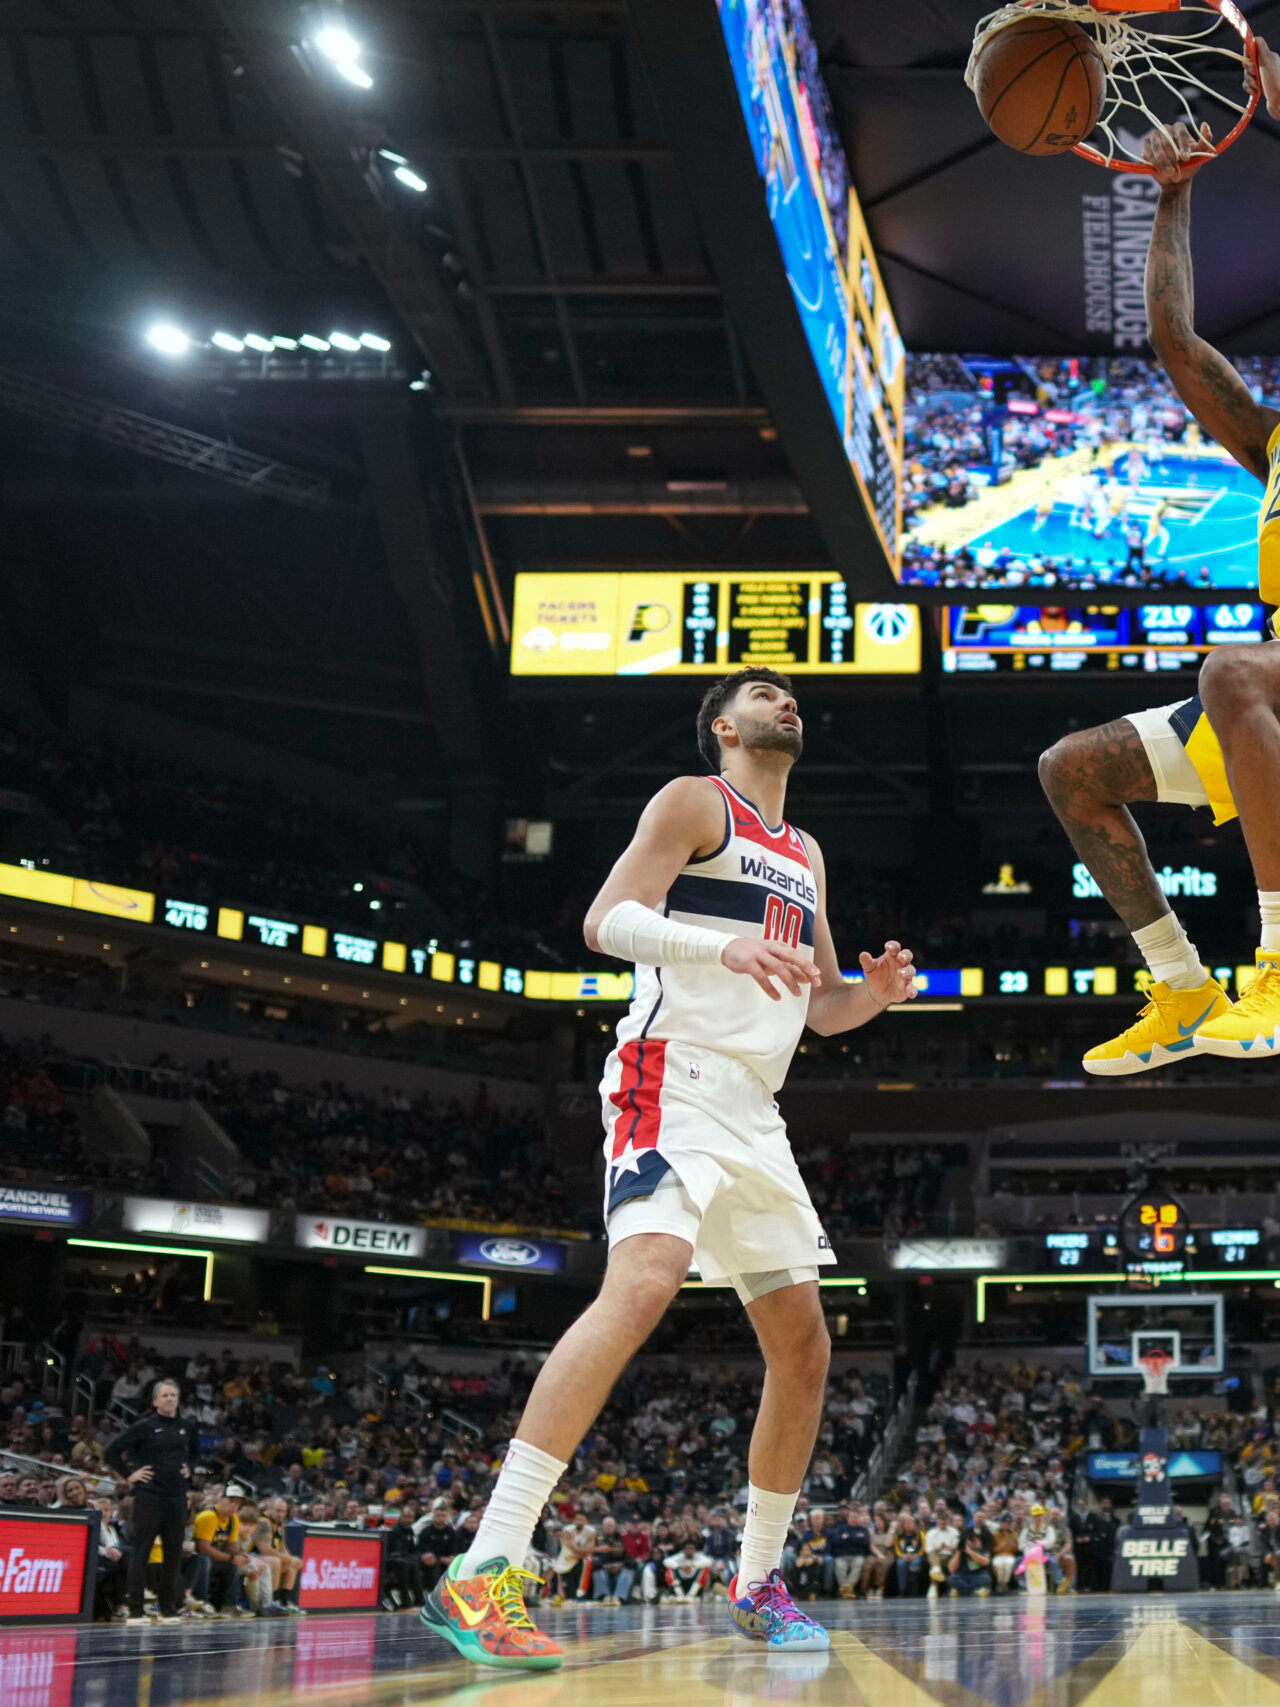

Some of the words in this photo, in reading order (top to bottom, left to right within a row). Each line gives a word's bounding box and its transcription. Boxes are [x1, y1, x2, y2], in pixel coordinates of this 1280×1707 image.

[1082, 195, 1112, 333] FIELDHOUSE
[166, 909, 206, 930] 4/10
[763, 895, 803, 950] 00
[260, 926, 287, 947] 1/2
[336, 943, 373, 963] 9/20
[414, 958, 422, 973] 1
[1258, 960, 1280, 970] KX
[1000, 971, 1028, 993] 23
[0, 1187, 71, 1208] FANDUEL
[0, 1202, 28, 1214] PORTS
[333, 1226, 410, 1251] DEEM
[1155, 1222, 1174, 1252] 6
[1060, 1249, 1080, 1265] 23
[1225, 1246, 1245, 1262] 21
[1138, 1506, 1170, 1516] BELLE
[1142, 1516, 1166, 1524] TIRE
[1121, 1540, 1189, 1558] BELLE
[1129, 1558, 1180, 1576] TIRE
